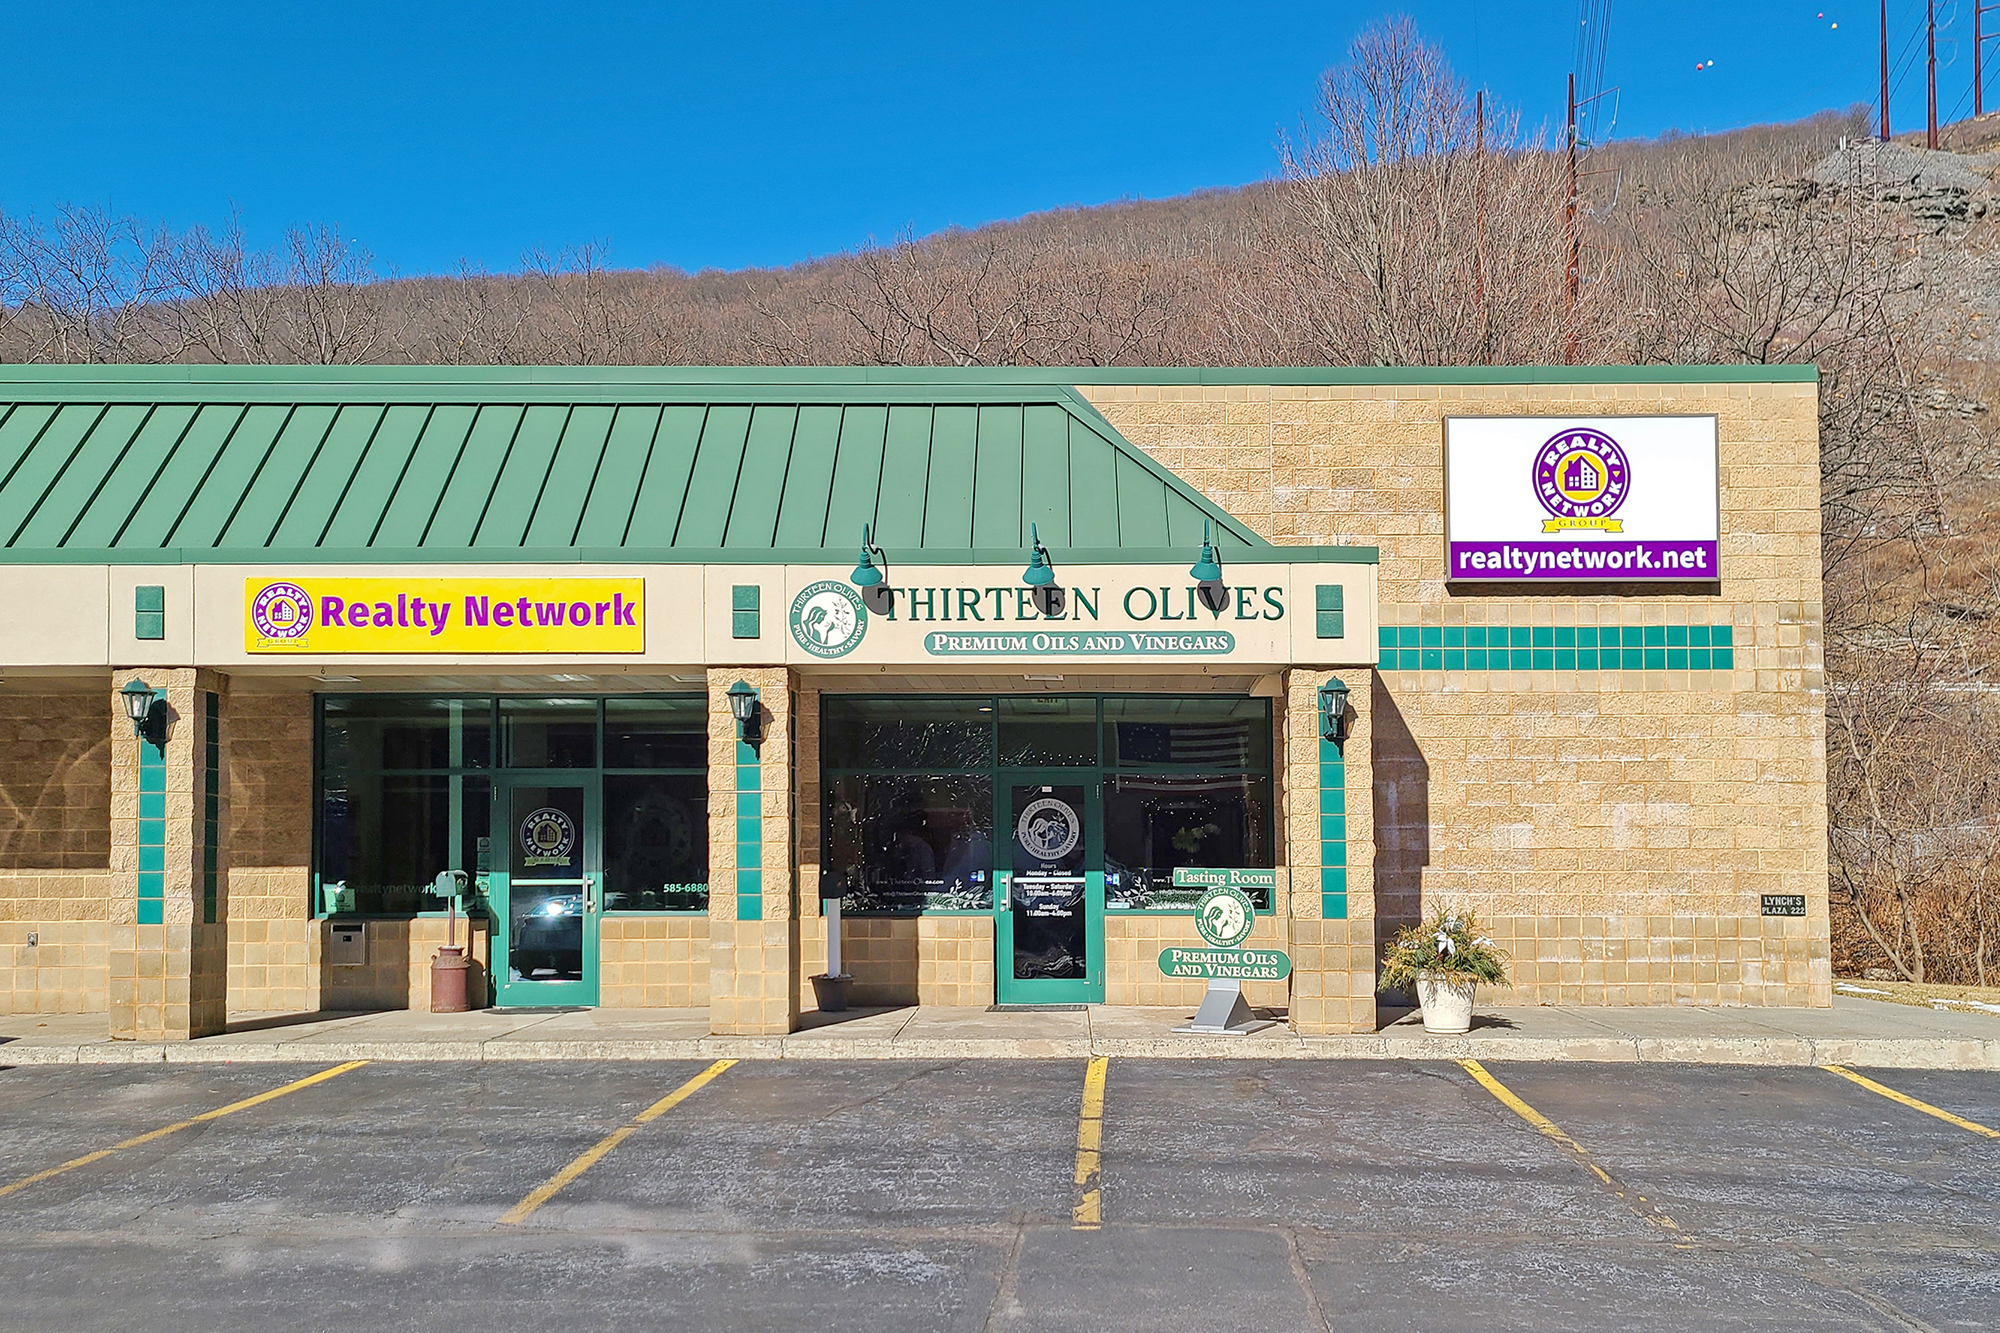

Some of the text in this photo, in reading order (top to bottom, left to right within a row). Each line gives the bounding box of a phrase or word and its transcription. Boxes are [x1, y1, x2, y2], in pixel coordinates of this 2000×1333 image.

[1543, 436, 1621, 467] REALTY
[1541, 481, 1623, 518] NETWORK
[1558, 519, 1607, 528] GROUP
[1459, 545, 1707, 575] realtynetwork.net
[258, 587, 308, 607] REALTY
[792, 582, 864, 614] THIRTEEN OLIVES
[877, 586, 1285, 622] THIRTEEN OLIVES
[320, 592, 637, 636] Realty Network
[257, 615, 309, 638] NETWORK
[793, 618, 865, 655] PURE HEALTHY SAVORY
[932, 633, 1229, 652] PREMIUM OILS AND VINEGARS
[527, 812, 569, 829] REALTY
[526, 837, 570, 857] NETWORK
[1032, 846, 1060, 857] HEALTHY
[1176, 869, 1227, 886] Tasting
[1229, 870, 1274, 884] Room
[663, 883, 708, 893] 585-6880
[1198, 888, 1250, 913] THIRTEEN OLIVES
[1764, 896, 1802, 905] LYNCH'S
[1762, 907, 1788, 915] PLAZA
[1171, 949, 1278, 965] PREMIUM OILS
[1172, 963, 1278, 978] AND VINEGARS
